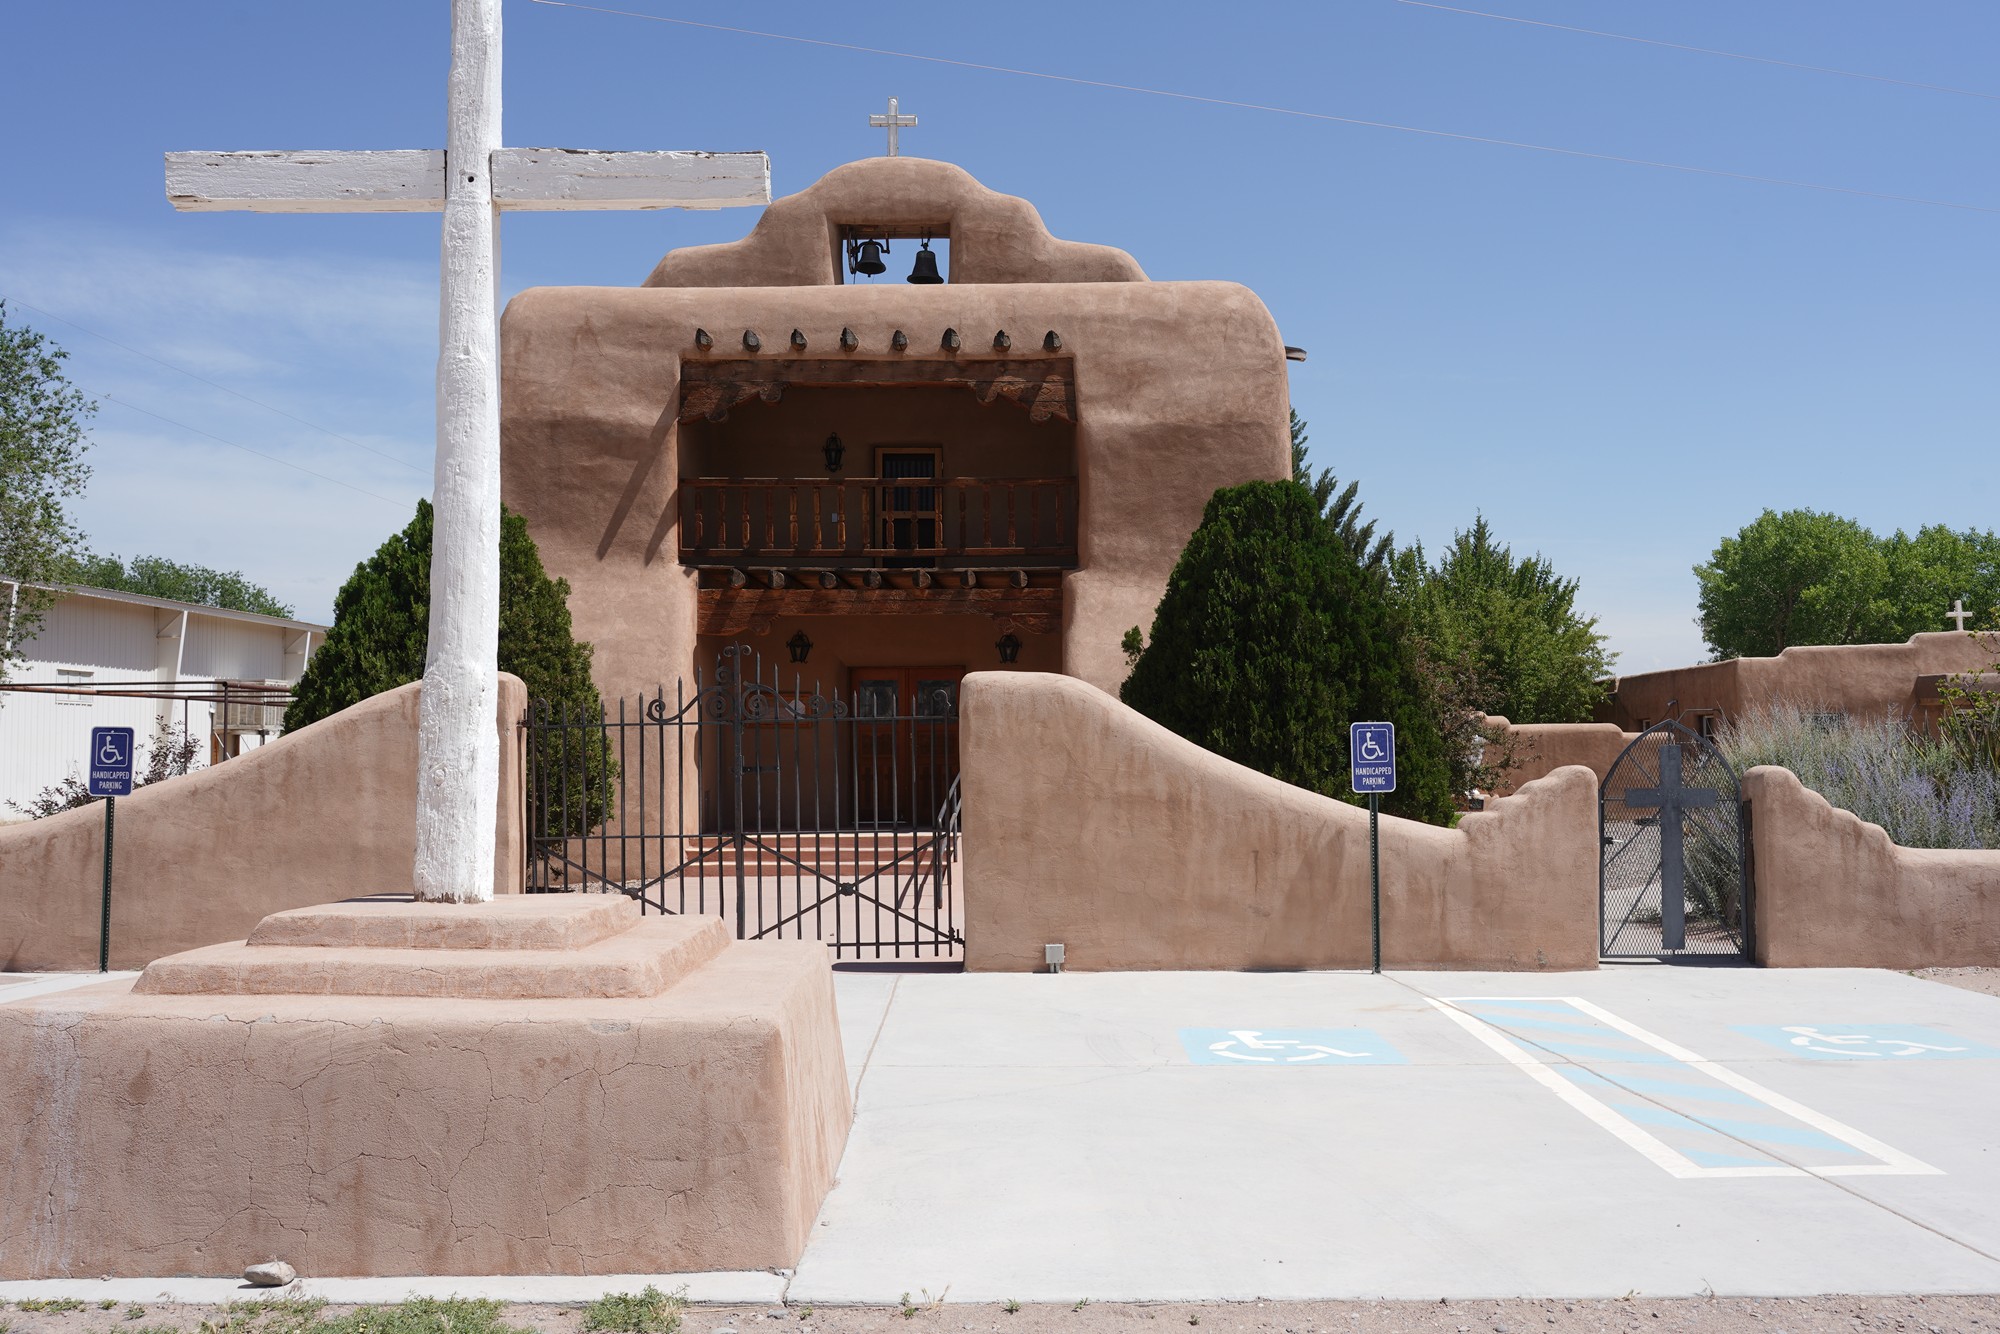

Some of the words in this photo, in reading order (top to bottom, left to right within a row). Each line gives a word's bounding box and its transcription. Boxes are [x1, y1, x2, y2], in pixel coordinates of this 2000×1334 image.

[92, 771, 130, 780] HANDICAPPED
[1355, 767, 1392, 776] HANDICAPPED
[98, 781, 122, 790] PARKING
[1362, 777, 1386, 785] PARKING
